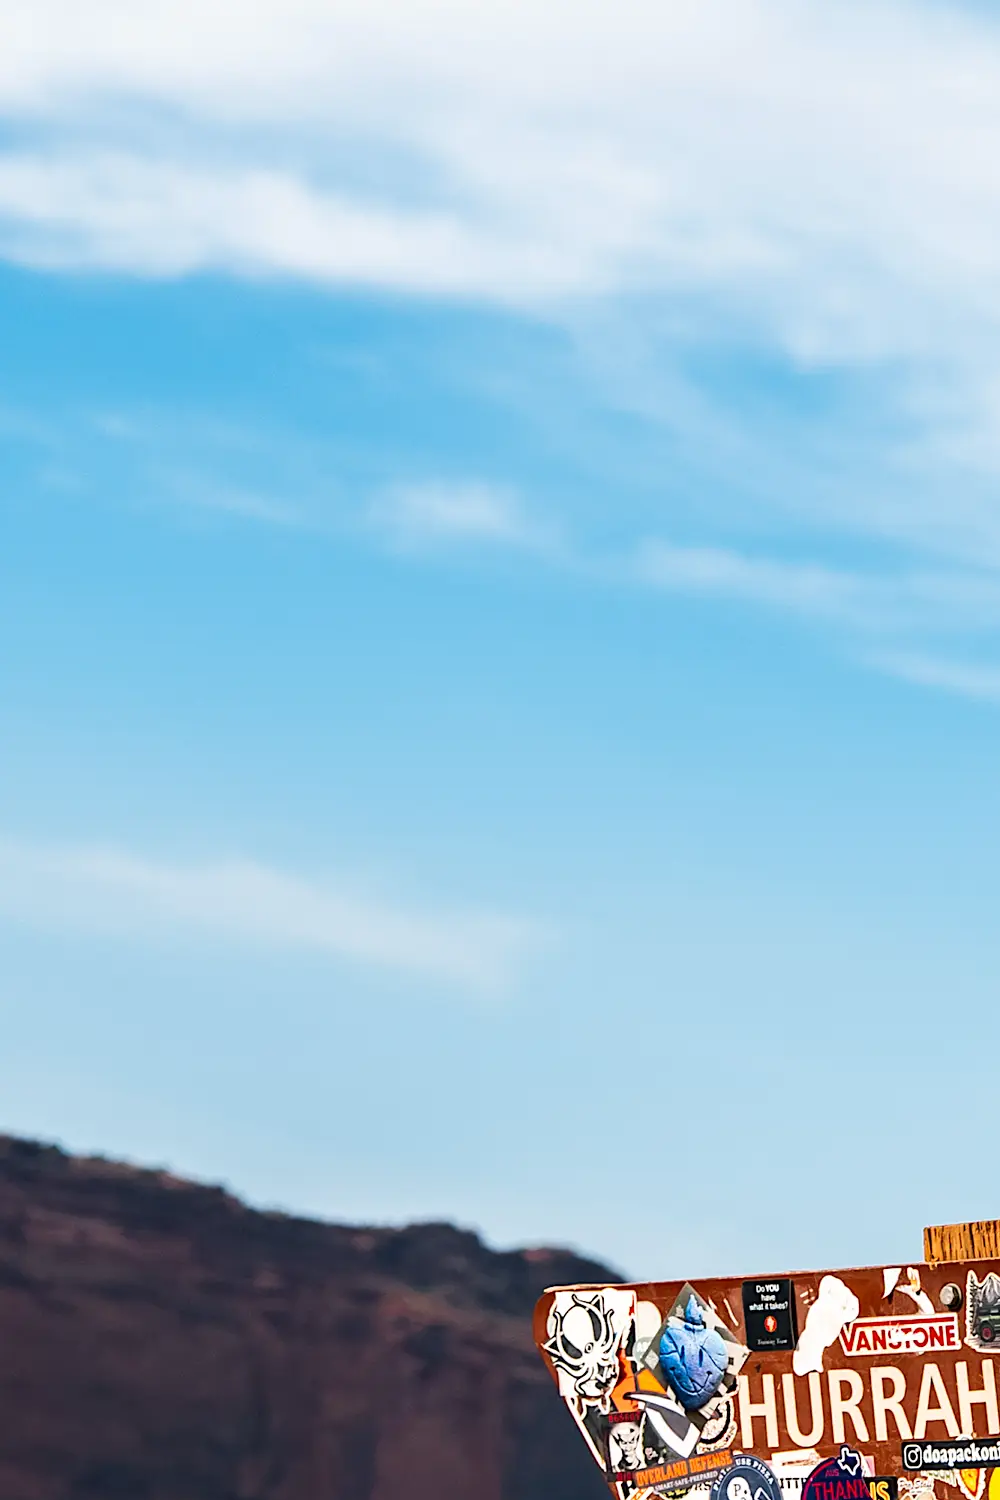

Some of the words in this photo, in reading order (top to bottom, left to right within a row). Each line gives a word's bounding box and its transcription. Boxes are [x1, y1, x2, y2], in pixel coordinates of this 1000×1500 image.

[756, 1285, 765, 1293] Do
[765, 1284, 780, 1292] YOU
[749, 1303, 764, 1311] what
[770, 1301, 788, 1311] takes?
[761, 1294, 776, 1302] have
[739, 1358, 1000, 1448] HURRAH
[635, 1460, 688, 1486] OVERLAND
[689, 1450, 732, 1473] DEFENSE
[753, 1461, 774, 1485] PIZZA
